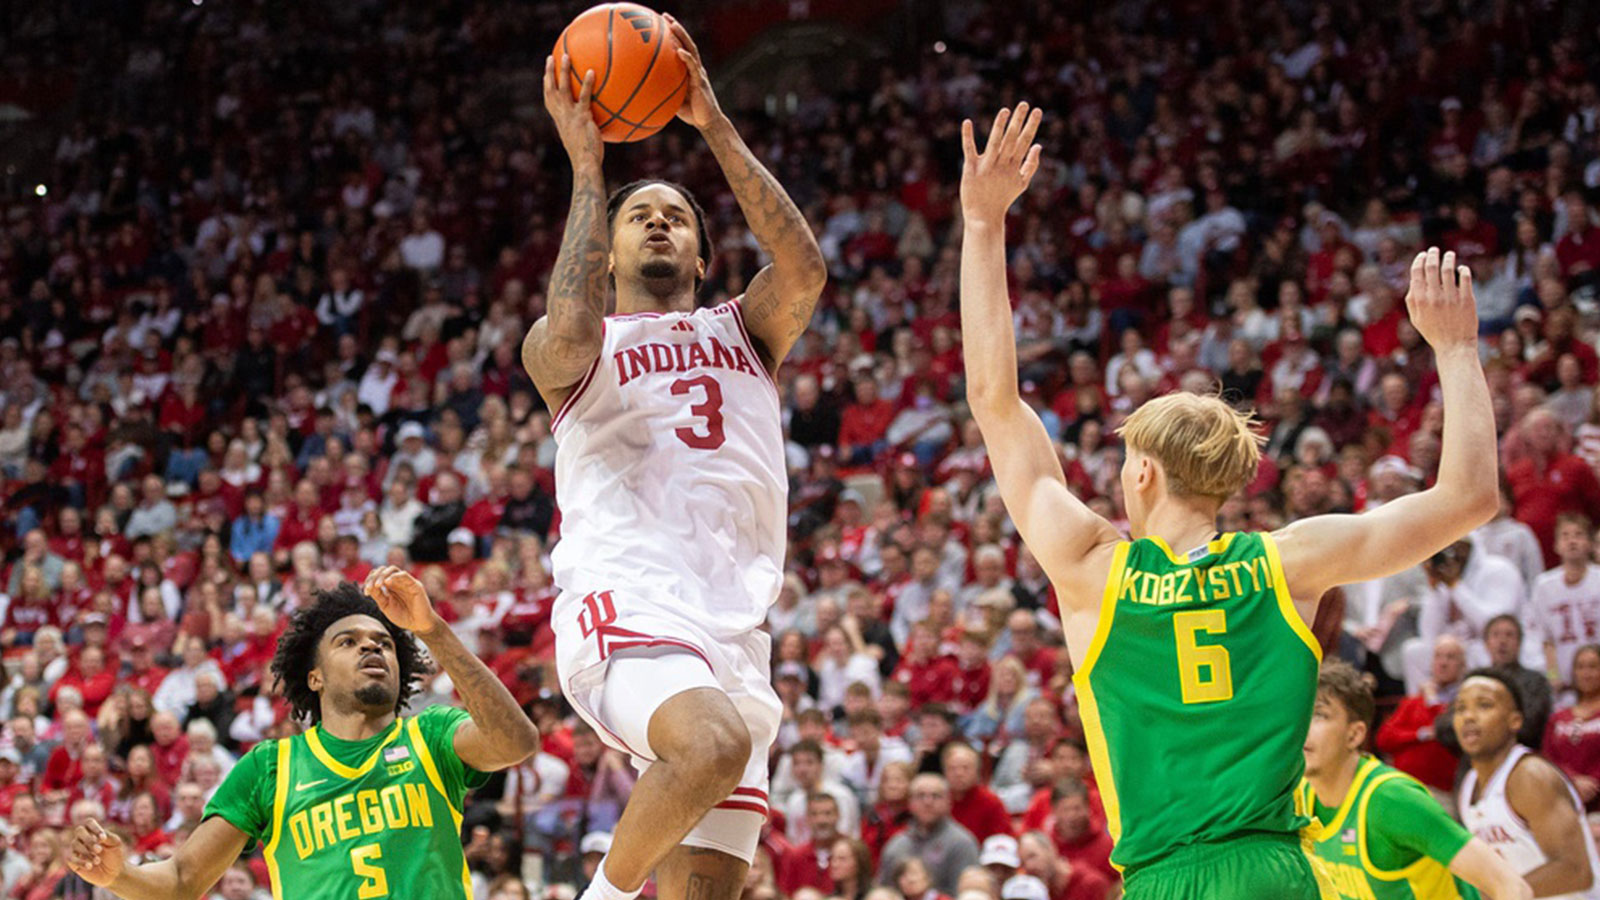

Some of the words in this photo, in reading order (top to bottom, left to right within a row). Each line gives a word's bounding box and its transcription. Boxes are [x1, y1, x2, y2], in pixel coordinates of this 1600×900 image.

[614, 336, 758, 387] INDIANA
[670, 374, 726, 450] 3
[1118, 556, 1273, 606] KOBZYSTYI
[1173, 609, 1233, 704] 6
[289, 783, 433, 860] OREGON
[350, 843, 389, 900] 5
